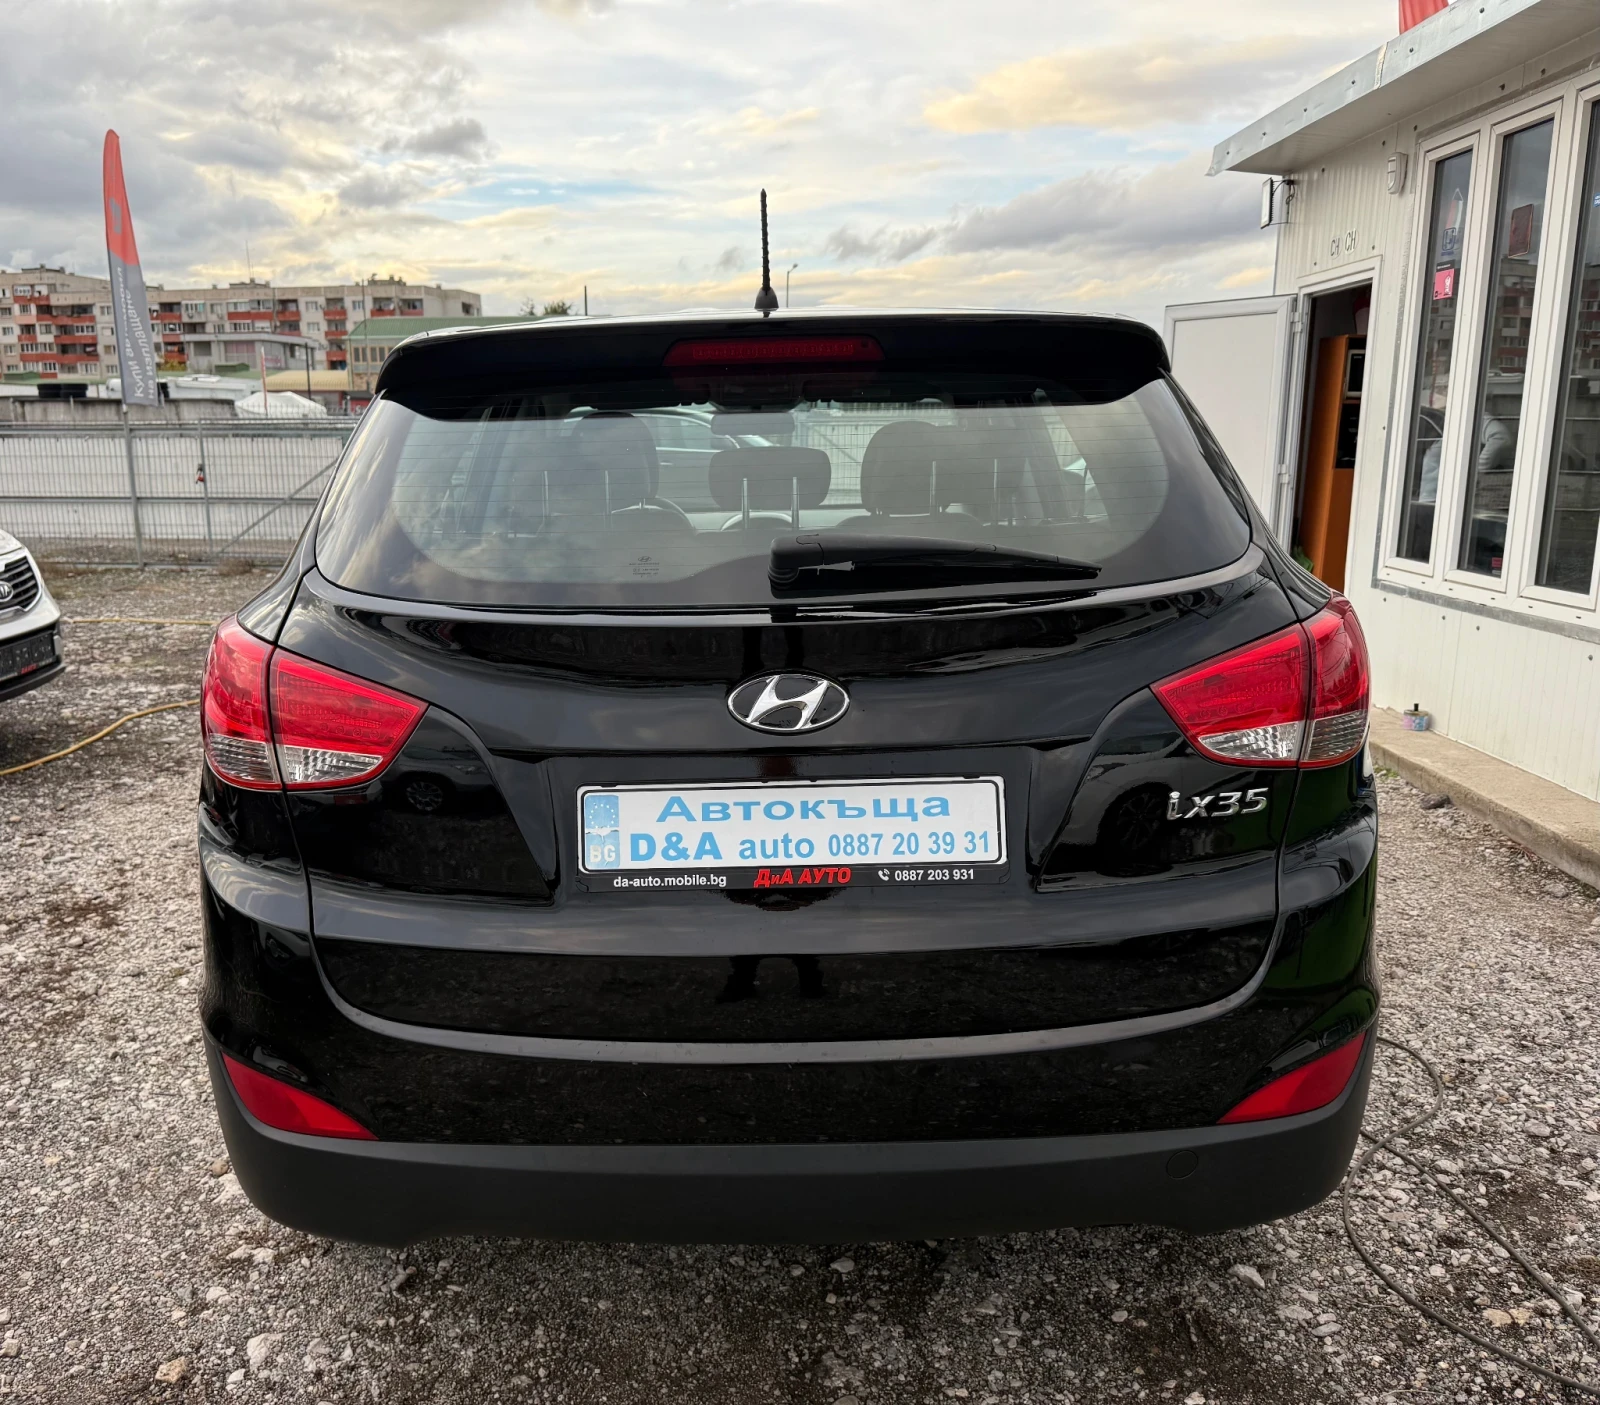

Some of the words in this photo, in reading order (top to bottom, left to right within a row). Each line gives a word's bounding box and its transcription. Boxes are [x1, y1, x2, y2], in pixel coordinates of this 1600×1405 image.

[656, 796, 950, 822] Автокъща
[1167, 787, 1269, 820] ix35
[589, 844, 616, 863] BG
[630, 832, 723, 862] D&A
[738, 834, 815, 860] auto
[828, 833, 884, 857] 0887
[892, 832, 919, 855] 20
[928, 831, 955, 855] 39
[963, 830, 989, 854] 31
[613, 873, 727, 889] da-auto.mobile.bg
[753, 868, 794, 888] ДиА
[798, 867, 852, 885] АУТО
[894, 870, 924, 881] 0887
[927, 869, 950, 881] 203
[953, 868, 974, 880] 931
